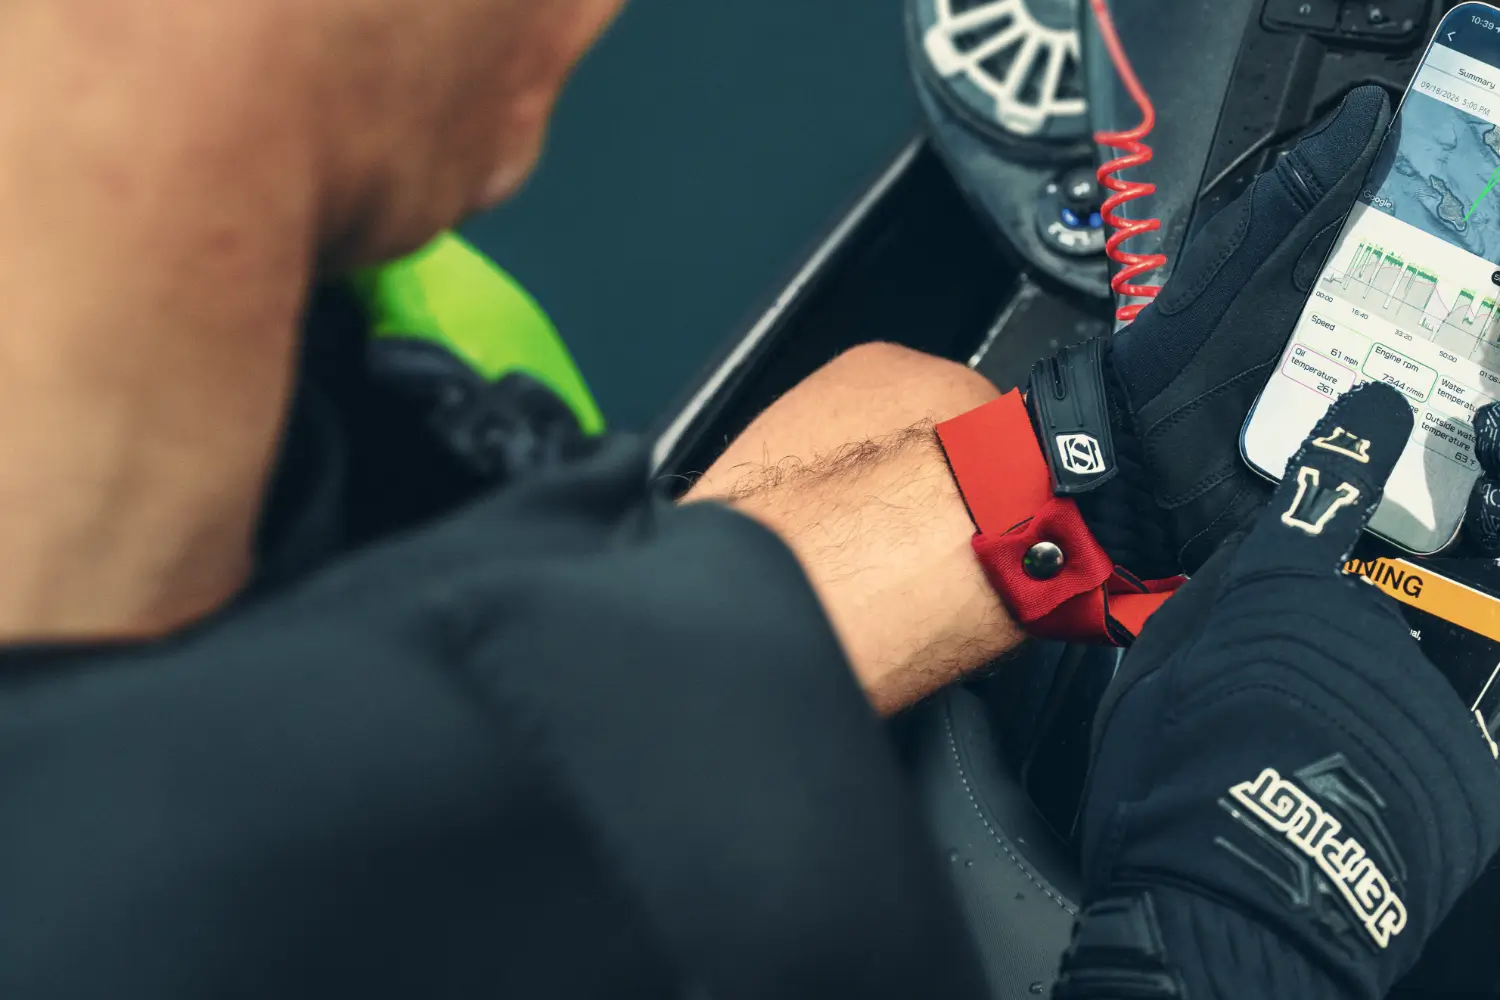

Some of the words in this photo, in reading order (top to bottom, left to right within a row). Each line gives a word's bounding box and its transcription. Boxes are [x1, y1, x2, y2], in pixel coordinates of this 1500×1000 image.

[1471, 15, 1494, 30] 10:39
[1458, 68, 1496, 90] Summary
[1421, 81, 1459, 103] 09/18/2026
[1462, 98, 1478, 112] 5:00
[1478, 105, 1490, 116] PM
[1363, 190, 1392, 209] Google
[1311, 315, 1336, 331] Speed
[1315, 291, 1333, 303] 00:00
[1352, 308, 1368, 320] 16:40
[1394, 329, 1413, 342] 33:20
[1439, 351, 1458, 363] 50:00
[1295, 347, 1306, 357] Oil
[1330, 348, 1342, 358] 61
[1344, 355, 1359, 367] mph
[1375, 346, 1402, 364] Engine
[1403, 361, 1419, 373] rpm
[1291, 357, 1338, 384] temperature
[1317, 382, 1334, 396] 261
[1382, 373, 1406, 390] 7344
[1406, 385, 1424, 399] r/min
[1441, 378, 1466, 395] Water
[1437, 388, 1478, 413] temperatu
[1421, 421, 1470, 451] temperature
[1425, 412, 1456, 433] Outside
[1457, 428, 1477, 443] wate
[1454, 452, 1468, 464] 63
[1348, 560, 1424, 598] NING
